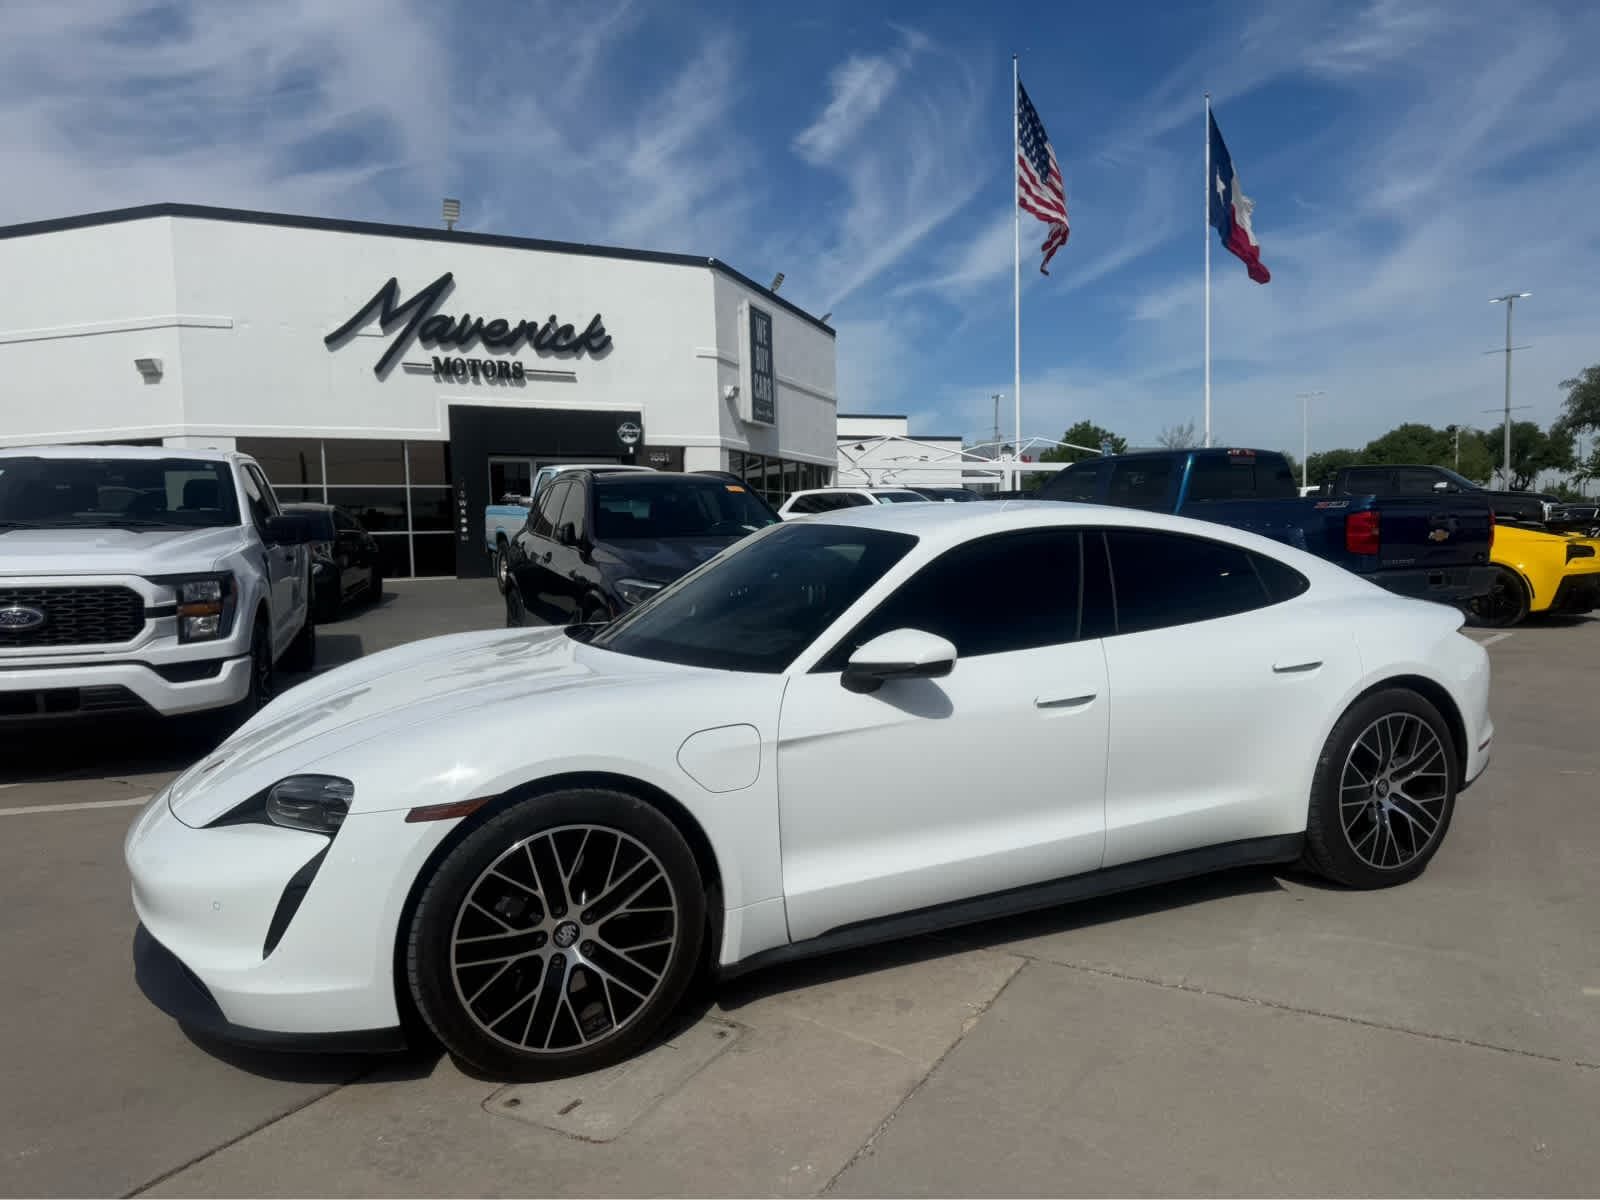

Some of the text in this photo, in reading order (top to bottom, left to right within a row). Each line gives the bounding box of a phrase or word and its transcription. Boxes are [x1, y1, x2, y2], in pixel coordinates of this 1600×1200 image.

[323, 271, 612, 374] Maverick
[755, 316, 768, 345] WE
[431, 356, 525, 381] MOTORS
[755, 345, 769, 372] BUY
[754, 373, 772, 402] CARS
